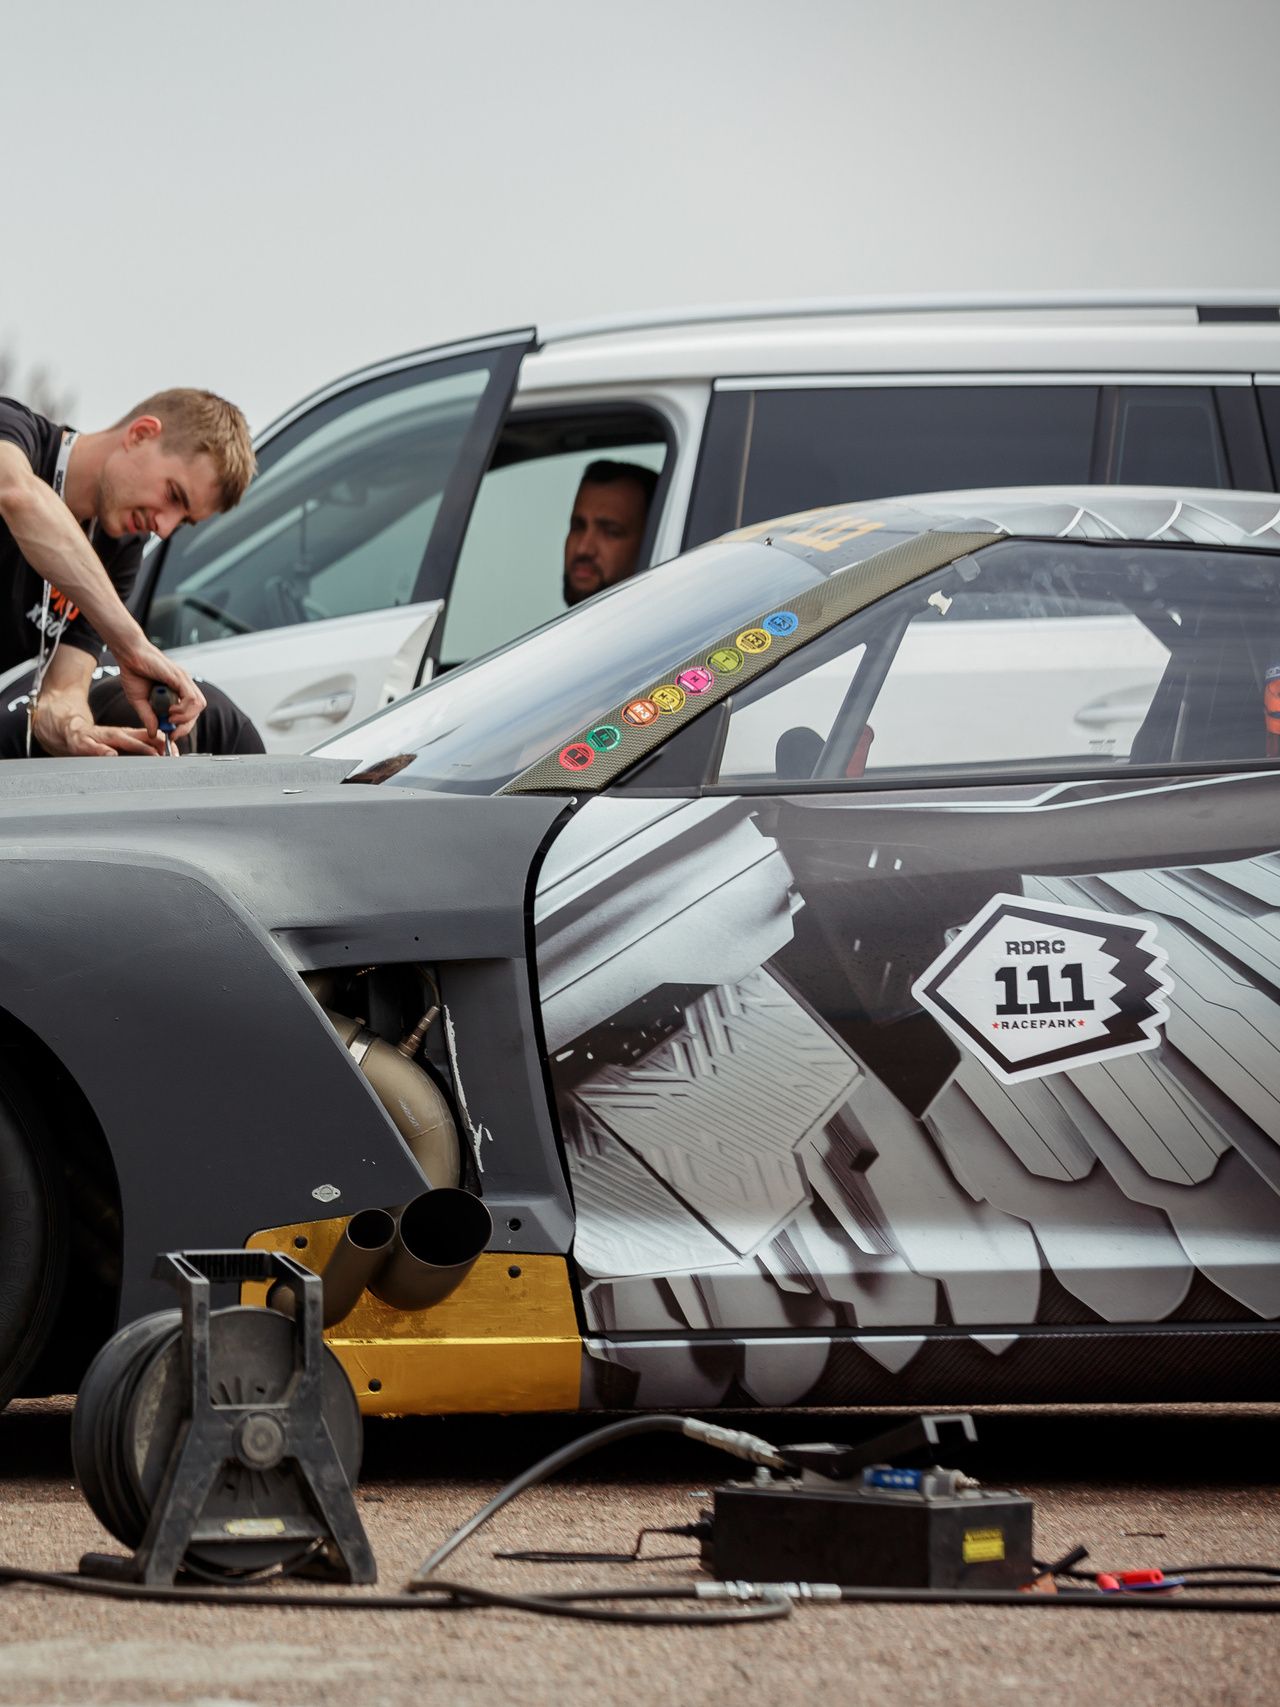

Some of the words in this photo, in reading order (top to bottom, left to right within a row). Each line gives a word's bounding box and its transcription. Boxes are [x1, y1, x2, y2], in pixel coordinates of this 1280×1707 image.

[1005, 939, 1066, 955] RDRC
[995, 963, 1095, 1015] 111
[1000, 1018, 1077, 1030] RACEPARK
